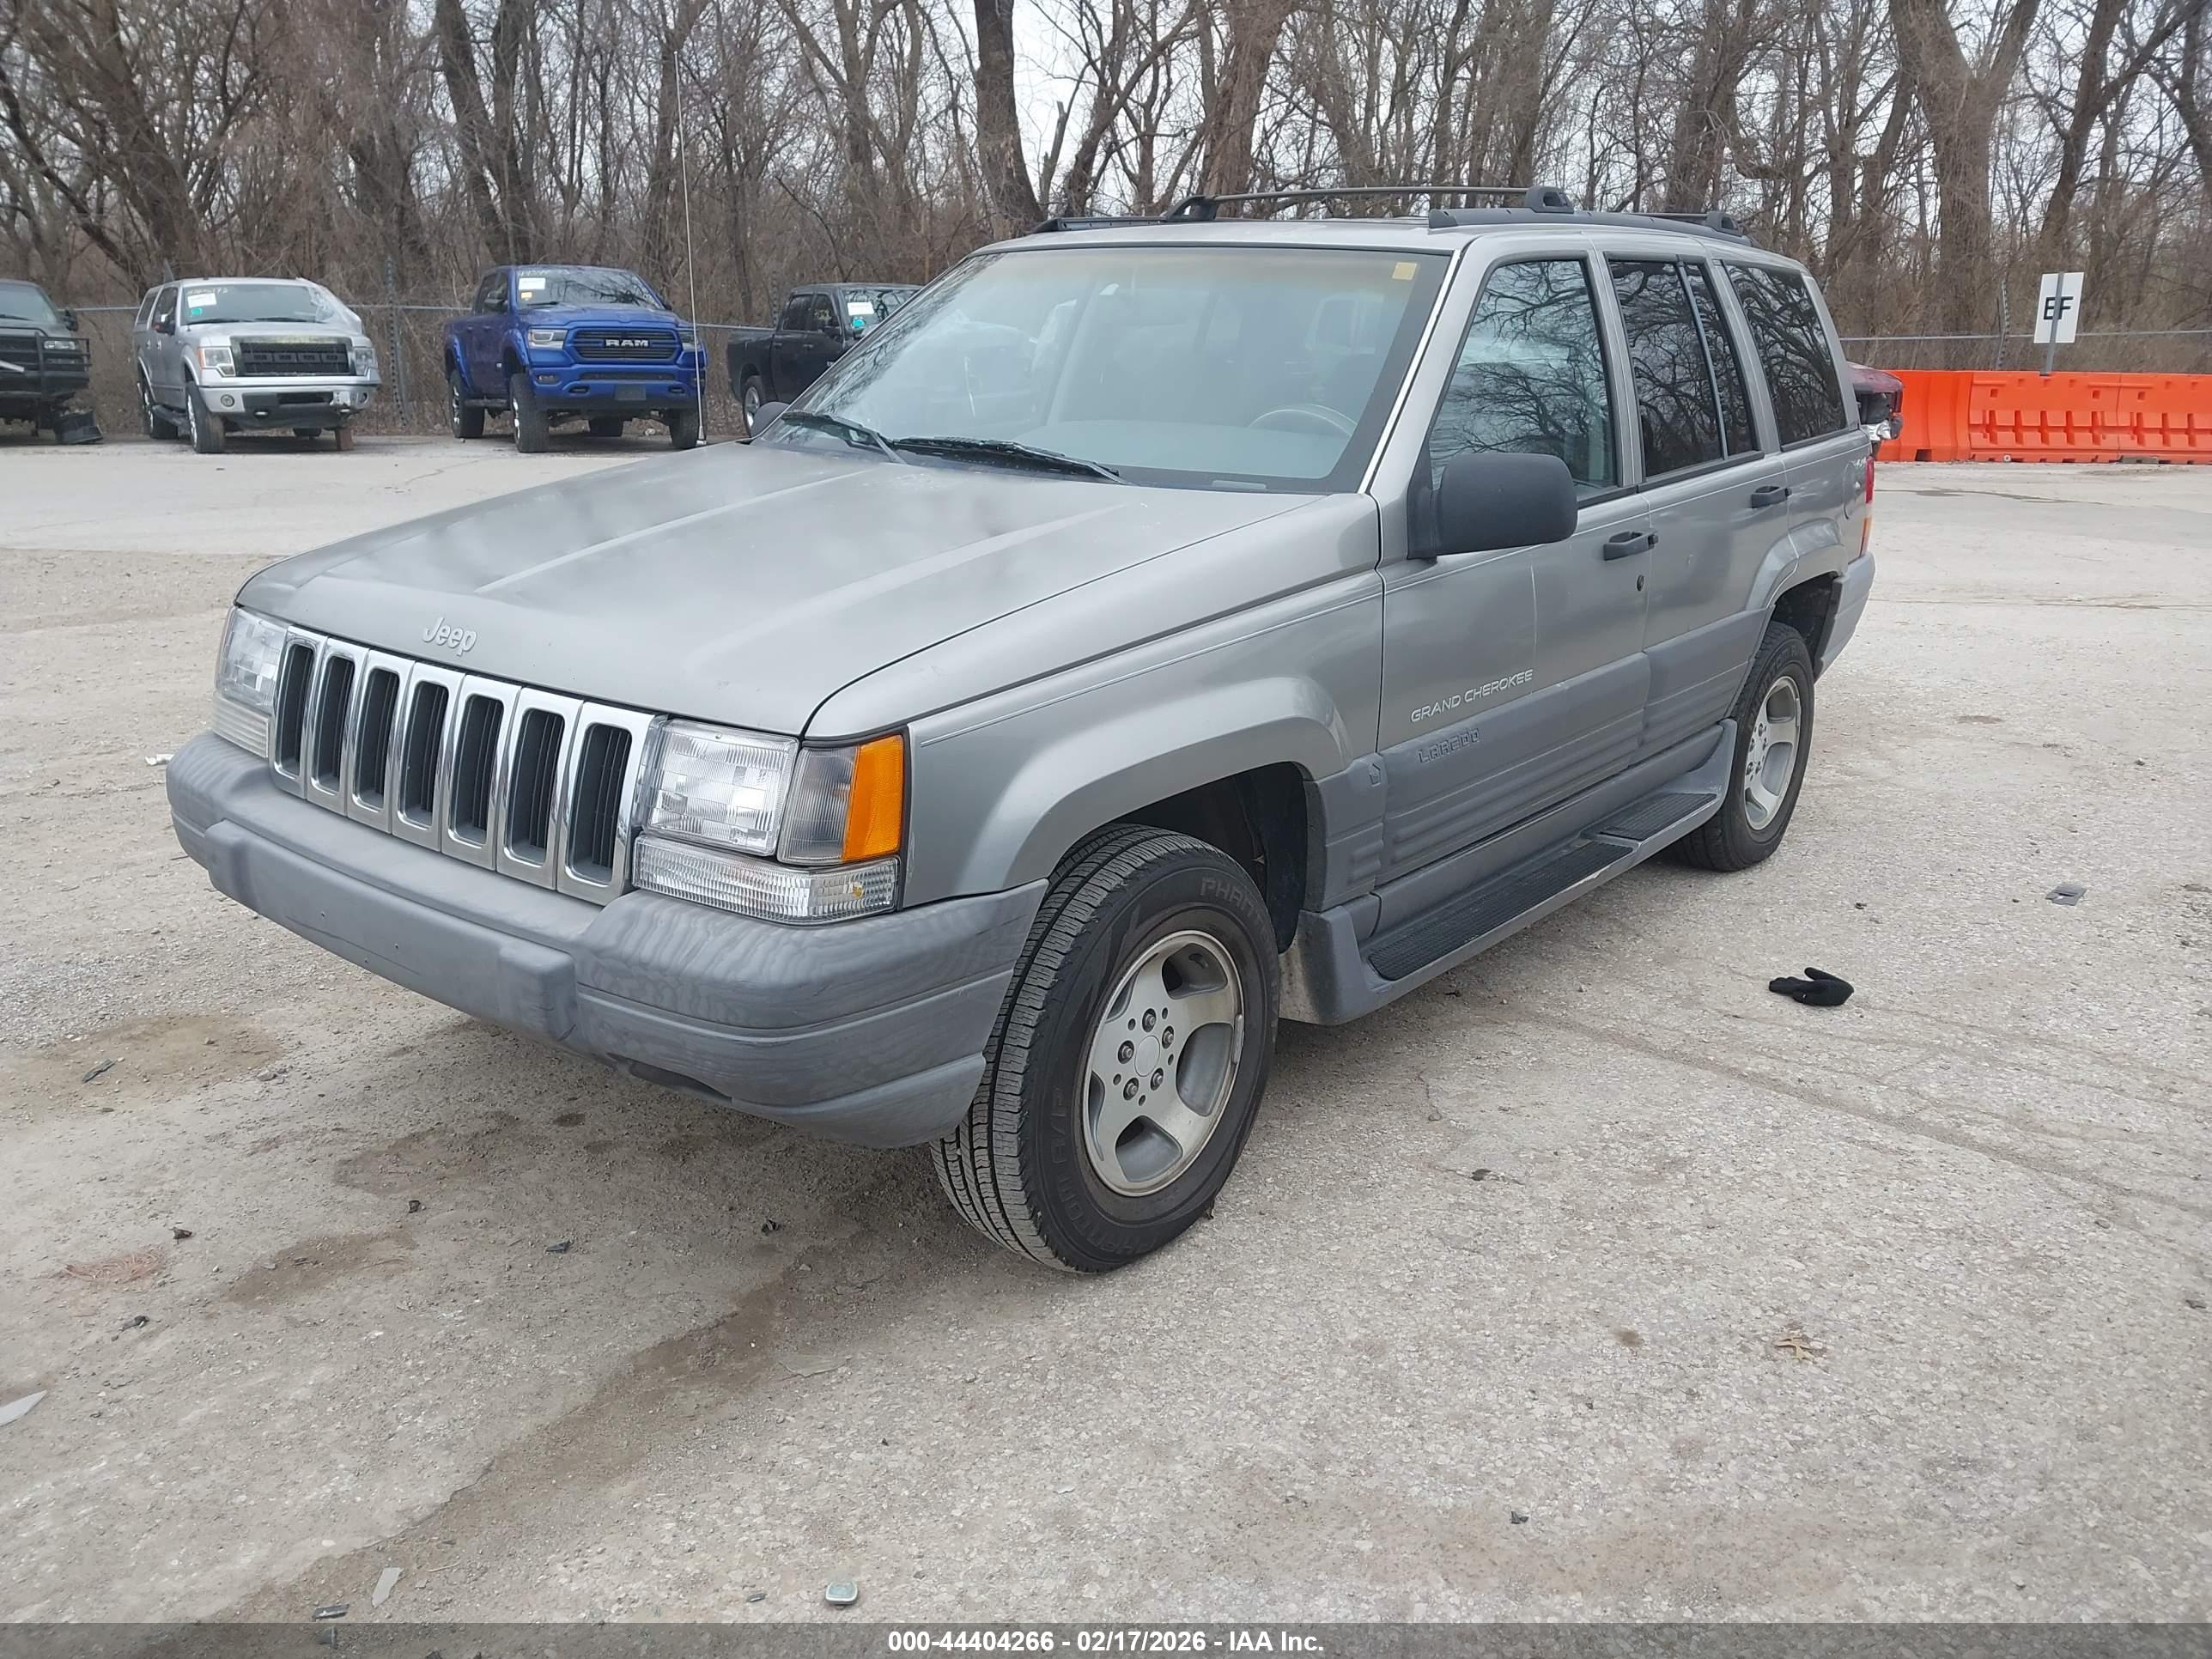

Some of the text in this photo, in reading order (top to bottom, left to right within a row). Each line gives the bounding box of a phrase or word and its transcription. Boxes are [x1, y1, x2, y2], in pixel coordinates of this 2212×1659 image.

[2043, 295, 2074, 320] EF
[422, 617, 478, 657] Jeep
[1410, 668, 1534, 723] GRAND CHEROKEE
[1418, 727, 1480, 763] LAREDO
